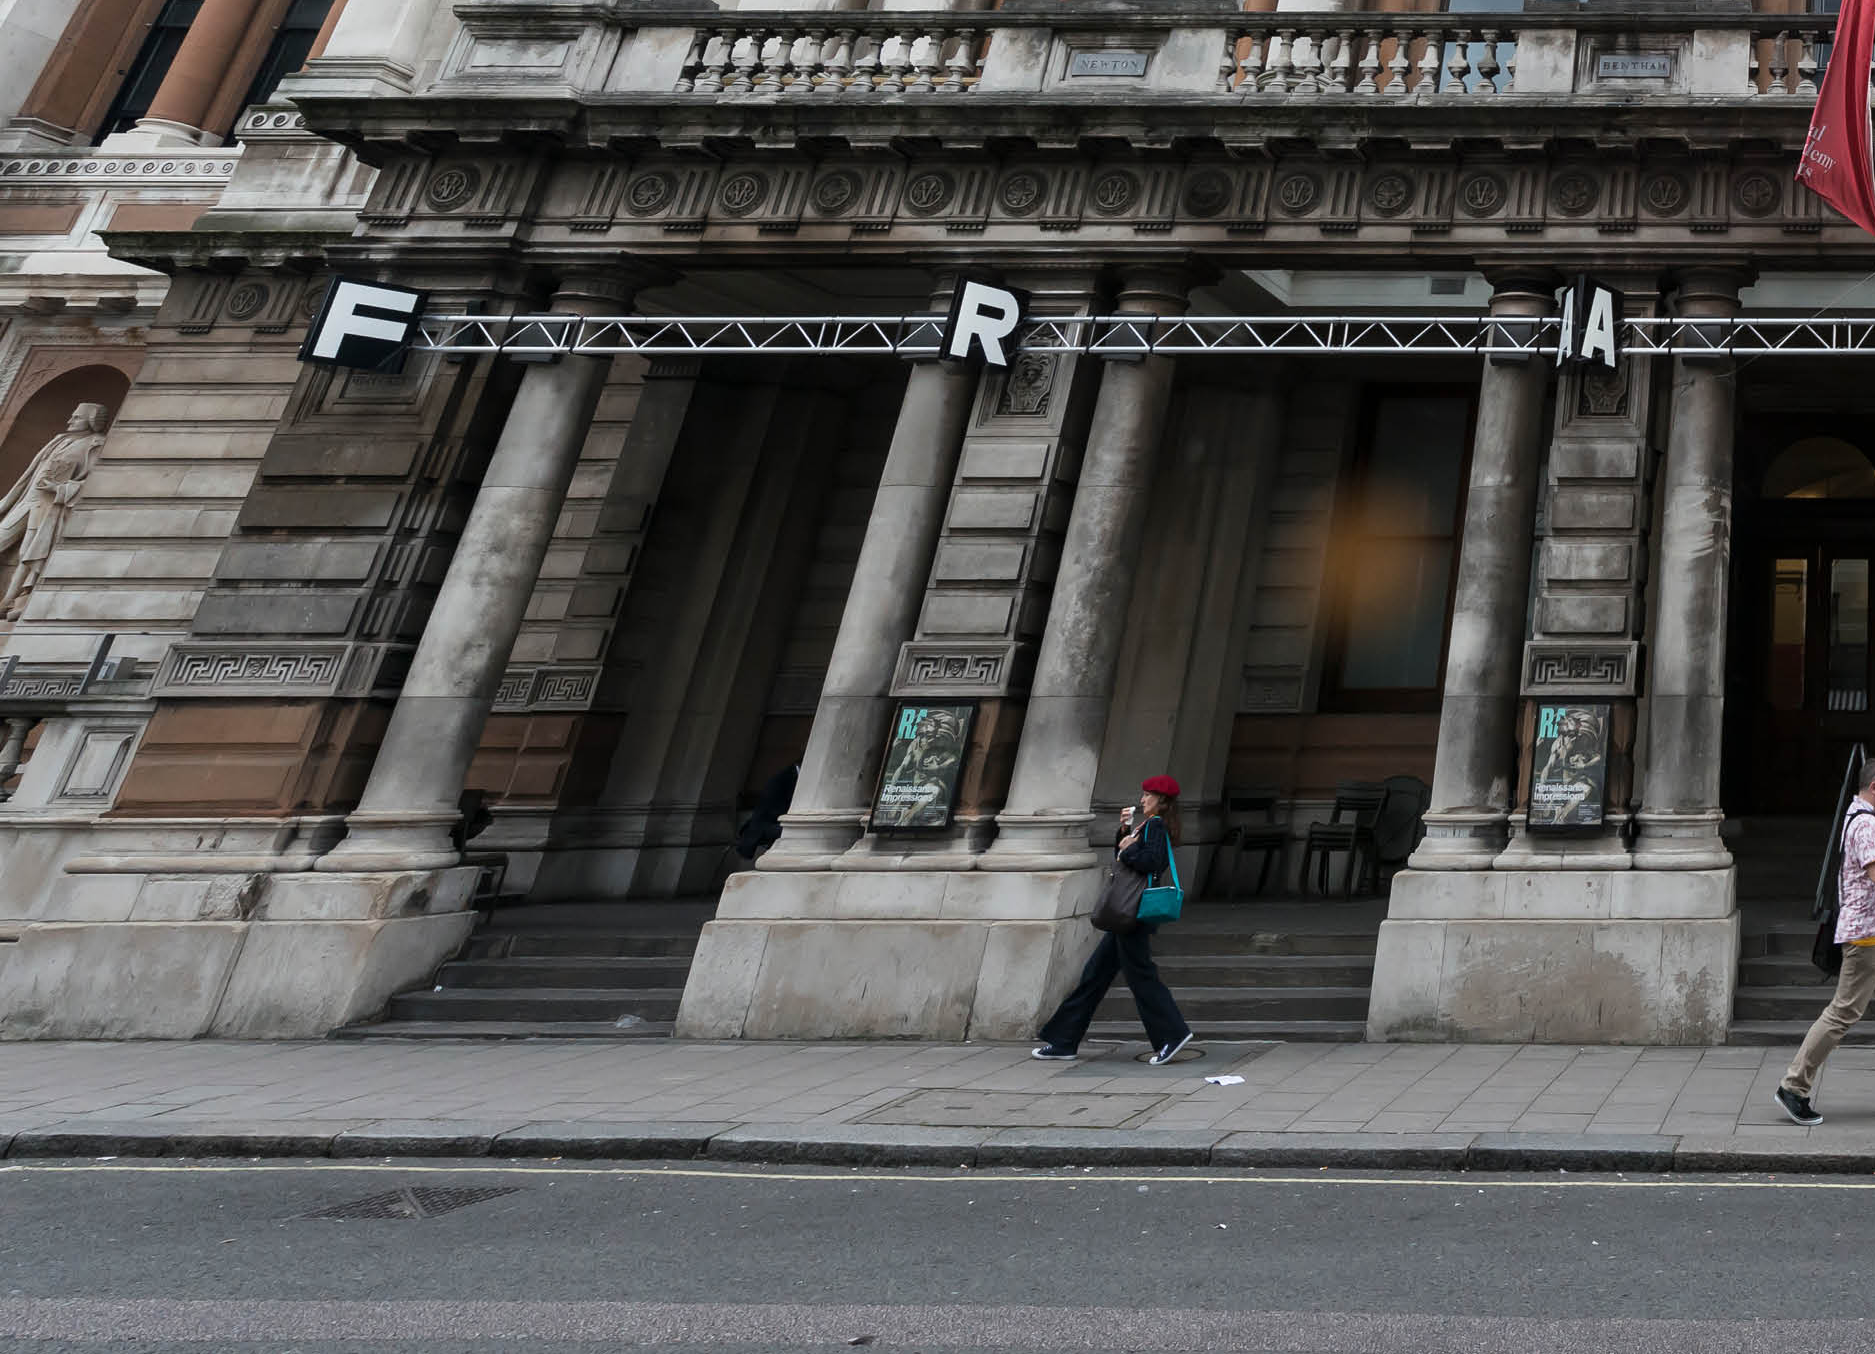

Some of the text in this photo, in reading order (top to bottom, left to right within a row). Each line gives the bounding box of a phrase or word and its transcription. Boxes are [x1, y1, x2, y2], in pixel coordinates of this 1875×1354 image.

[1081, 60, 1138, 71] NEWTON
[1603, 61, 1666, 71] BENTHAM
[313, 282, 417, 358] F
[950, 281, 1019, 366] R
[1534, 792, 1585, 803] Impressions
